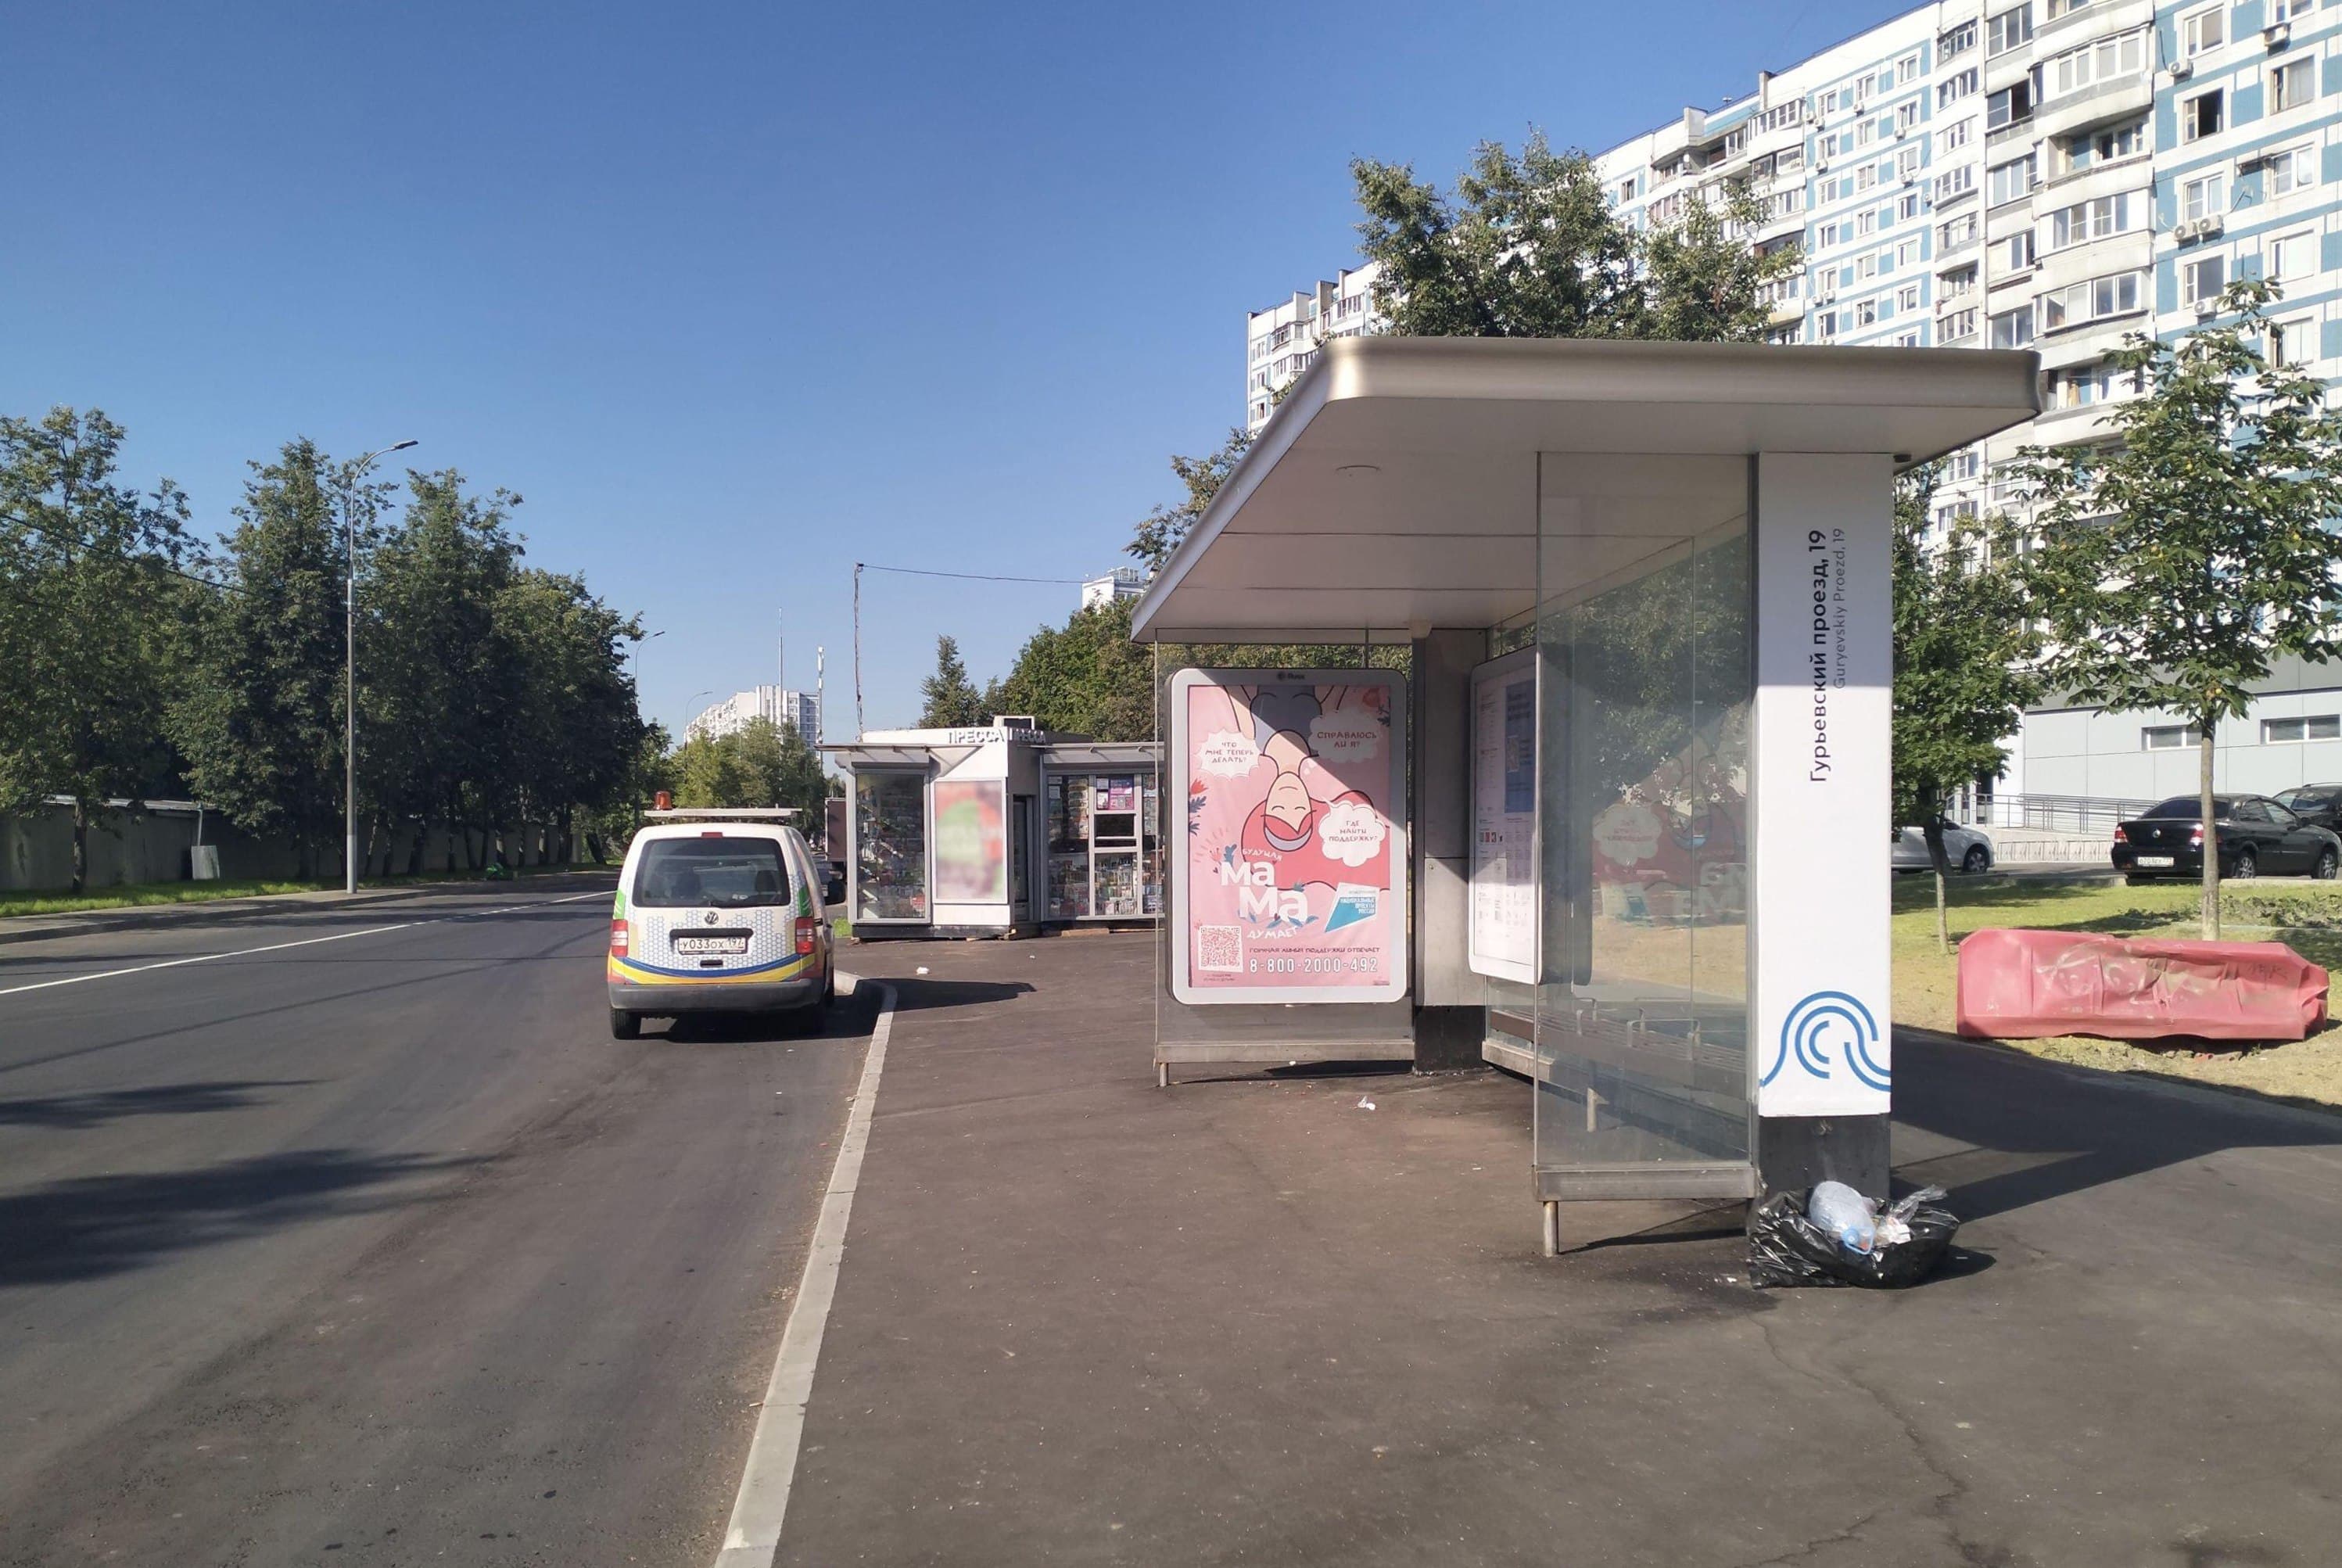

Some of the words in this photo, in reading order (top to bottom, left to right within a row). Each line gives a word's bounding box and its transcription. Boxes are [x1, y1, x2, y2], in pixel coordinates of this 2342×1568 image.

[1808, 529, 1827, 553] 19
[1832, 528, 1845, 543] 19
[1832, 547, 1846, 602] Proezd,
[1813, 558, 1831, 645] проезд,
[1832, 605, 1848, 690] Guryevskiy
[1809, 652, 1831, 781] Гурьевский
[949, 727, 1006, 745] ПРЕССА
[1242, 849, 1282, 861] БУДУЩАЯ
[1247, 928, 1297, 939] ДУМАЕТ
[1250, 957, 1379, 973] 8-800-2000-492
